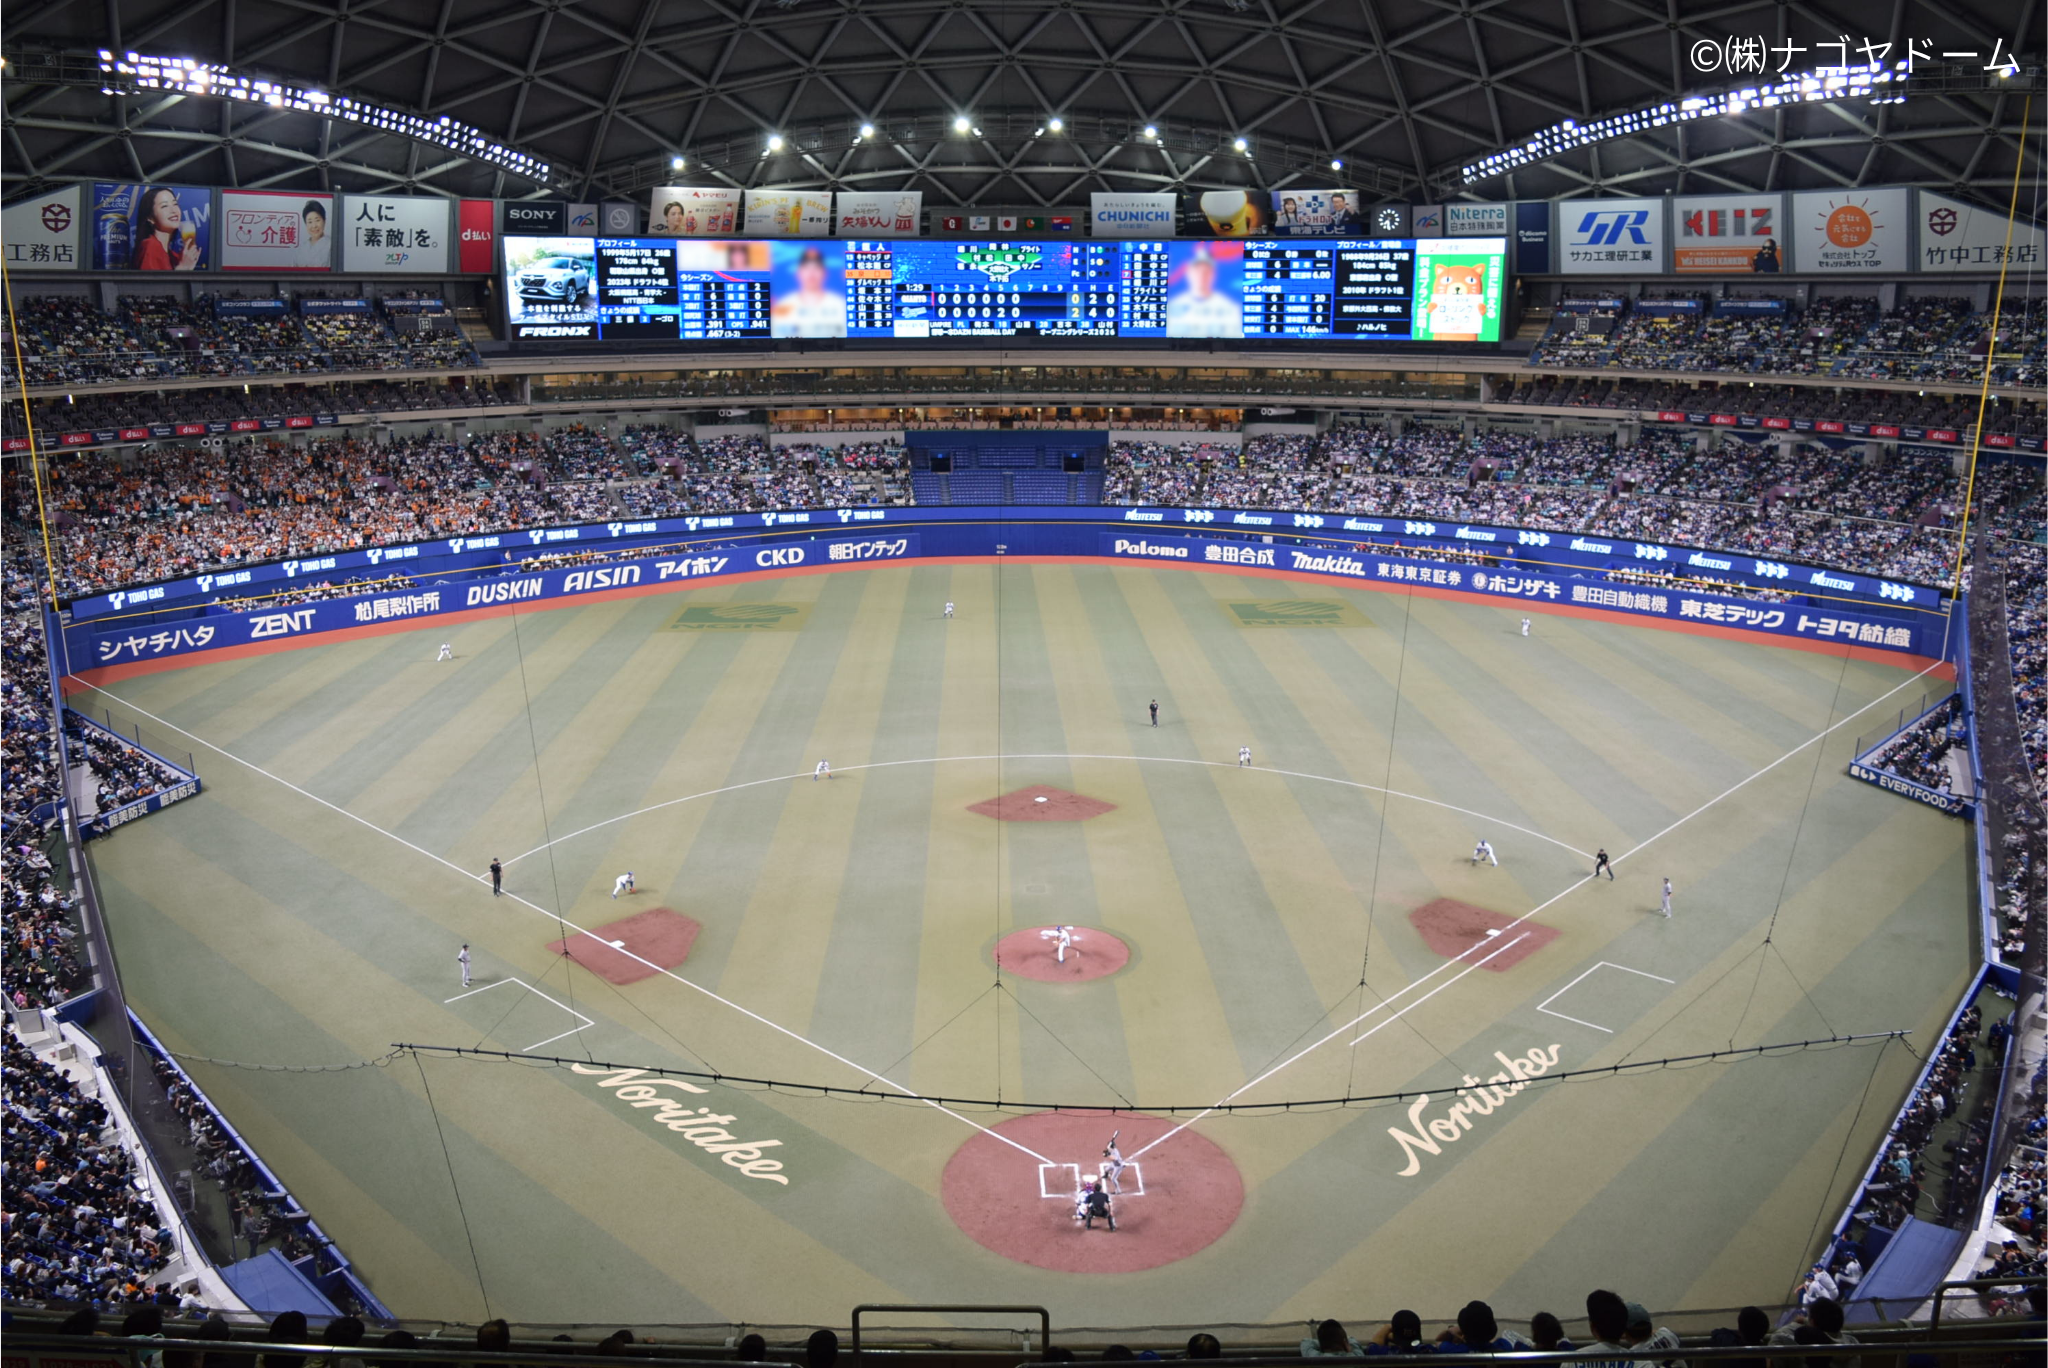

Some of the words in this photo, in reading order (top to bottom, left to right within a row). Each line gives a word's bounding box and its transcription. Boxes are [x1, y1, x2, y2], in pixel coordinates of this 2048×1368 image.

[356, 202, 396, 222] 人に
[806, 200, 828, 212] BREW
[1450, 207, 1505, 220] Niterra
[509, 209, 557, 220] SONY
[842, 216, 891, 228] 矢場とん
[1097, 211, 1170, 222] CHUNICHI
[261, 226, 297, 245] 介護
[355, 228, 438, 248] 「素敵」を。
[462, 228, 491, 242] d払い
[1290, 226, 1346, 235] 東海テレビ
[1841, 234, 1859, 242] 会社
[2, 243, 73, 263] 工務店
[1139, 243, 1163, 252] 中日
[1853, 249, 1877, 259] トップ
[1926, 244, 2037, 265] 竹中工務店
[680, 273, 713, 281] 今シーズン
[1274, 271, 1280, 279] 4
[1313, 271, 1331, 279] 6.00
[938, 294, 946, 304] 0
[953, 294, 961, 304] 0
[968, 294, 976, 304] 0
[982, 294, 990, 304] 0
[997, 294, 1005, 304] 0
[1012, 294, 1019, 304] 0
[1072, 294, 1079, 304] 0
[1089, 294, 1097, 304] 2
[1107, 294, 1115, 304] 0
[1271, 294, 1277, 302] 6
[1315, 294, 1325, 302] 20
[938, 307, 946, 317] 0
[953, 307, 961, 317] 0
[968, 307, 976, 317] 0
[982, 307, 990, 317] 0
[997, 307, 1005, 317] 2
[1012, 307, 1019, 317] 0
[1072, 307, 1079, 317] 2
[1089, 307, 1097, 317] 4
[1107, 307, 1115, 317] 0
[1316, 315, 1322, 323] 0
[519, 326, 591, 337] FRONX
[707, 330, 724, 338] .667
[702, 518, 719, 527] TOHO
[719, 517, 733, 526] GAS
[778, 514, 795, 523] TOHO
[796, 513, 809, 522] GAS
[854, 511, 870, 519] TOHO
[871, 511, 884, 519] GAS
[1125, 508, 1163, 521] MEITETSU
[1233, 511, 1272, 525] MEITETSU
[624, 524, 642, 533] TOHO
[643, 523, 657, 532] GAS
[1344, 518, 1383, 532] MEITETSU
[547, 530, 564, 540] TOHO
[565, 529, 578, 539] GAS
[1455, 526, 1496, 542] MEITETSU
[466, 539, 484, 550] TOHO
[484, 537, 499, 547] GAS
[828, 539, 907, 560] 朝日インテック
[1114, 539, 1188, 557] Paloma
[1570, 537, 1612, 554] MEITETSU
[385, 548, 402, 559] TOHO
[403, 546, 418, 557] GAS
[756, 547, 805, 567] CKD
[1204, 544, 1275, 567] 豊田合成
[301, 561, 320, 573] TOHO
[320, 558, 335, 570] GAS
[655, 557, 729, 579] アイホン
[1291, 551, 1366, 576] Makita
[1688, 552, 1731, 571] MEITETSU
[216, 575, 235, 586] TOHO
[235, 572, 251, 584] GAS
[563, 565, 641, 592] AISIN
[1377, 562, 1462, 586] 東海東京証券
[1810, 570, 1855, 591] MEITETSU
[1488, 576, 1561, 599] ホシザキ
[128, 590, 147, 604] TOHO
[148, 587, 164, 600] GAS
[1571, 585, 1668, 614] 豊田自動織機
[355, 591, 440, 622] 松尾製作所
[1679, 599, 1785, 628] 東芝テック
[249, 609, 316, 639] ZENT
[1796, 615, 1911, 648] トヨタ紡織
[159, 782, 197, 808] 能美防災
[1879, 775, 1948, 809] EVERYFOOD
[108, 801, 149, 829] 能美防災
[1387, 1044, 1561, 1177] Noritake
[571, 1062, 789, 1185] Noritake
